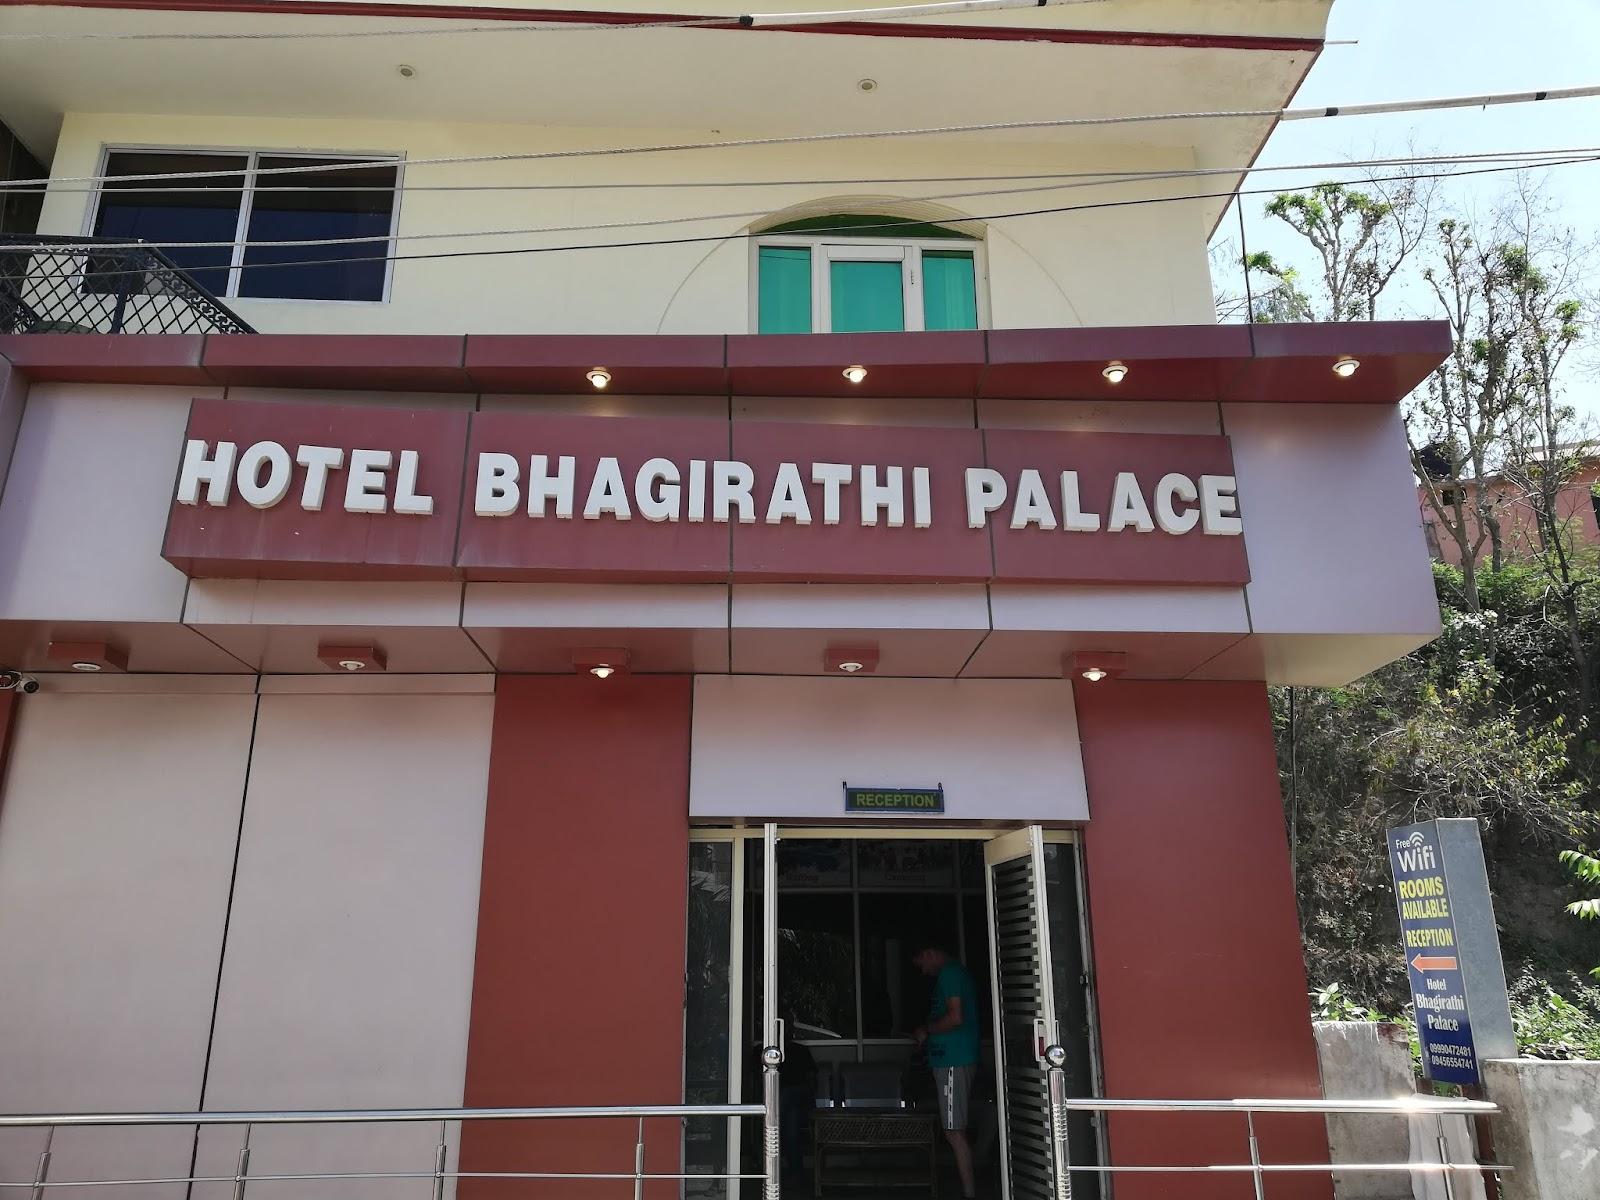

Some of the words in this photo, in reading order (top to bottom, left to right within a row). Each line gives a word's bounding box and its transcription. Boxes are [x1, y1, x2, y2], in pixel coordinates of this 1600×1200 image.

[177, 440, 433, 515] HOTEL
[475, 453, 932, 528] BHAGIRATHI
[965, 468, 1242, 535] PALACE
[857, 794, 935, 807] RECEPTION
[1396, 840, 1411, 849] Free
[1397, 845, 1436, 872] Wifi
[1399, 876, 1444, 899] ROOMS
[1402, 898, 1449, 919] AVAILABLE
[1406, 928, 1454, 947] RECEPTION
[1427, 978, 1447, 990] Hotel
[1416, 993, 1464, 1012] Bhagirathi
[1427, 1014, 1459, 1031] Palace
